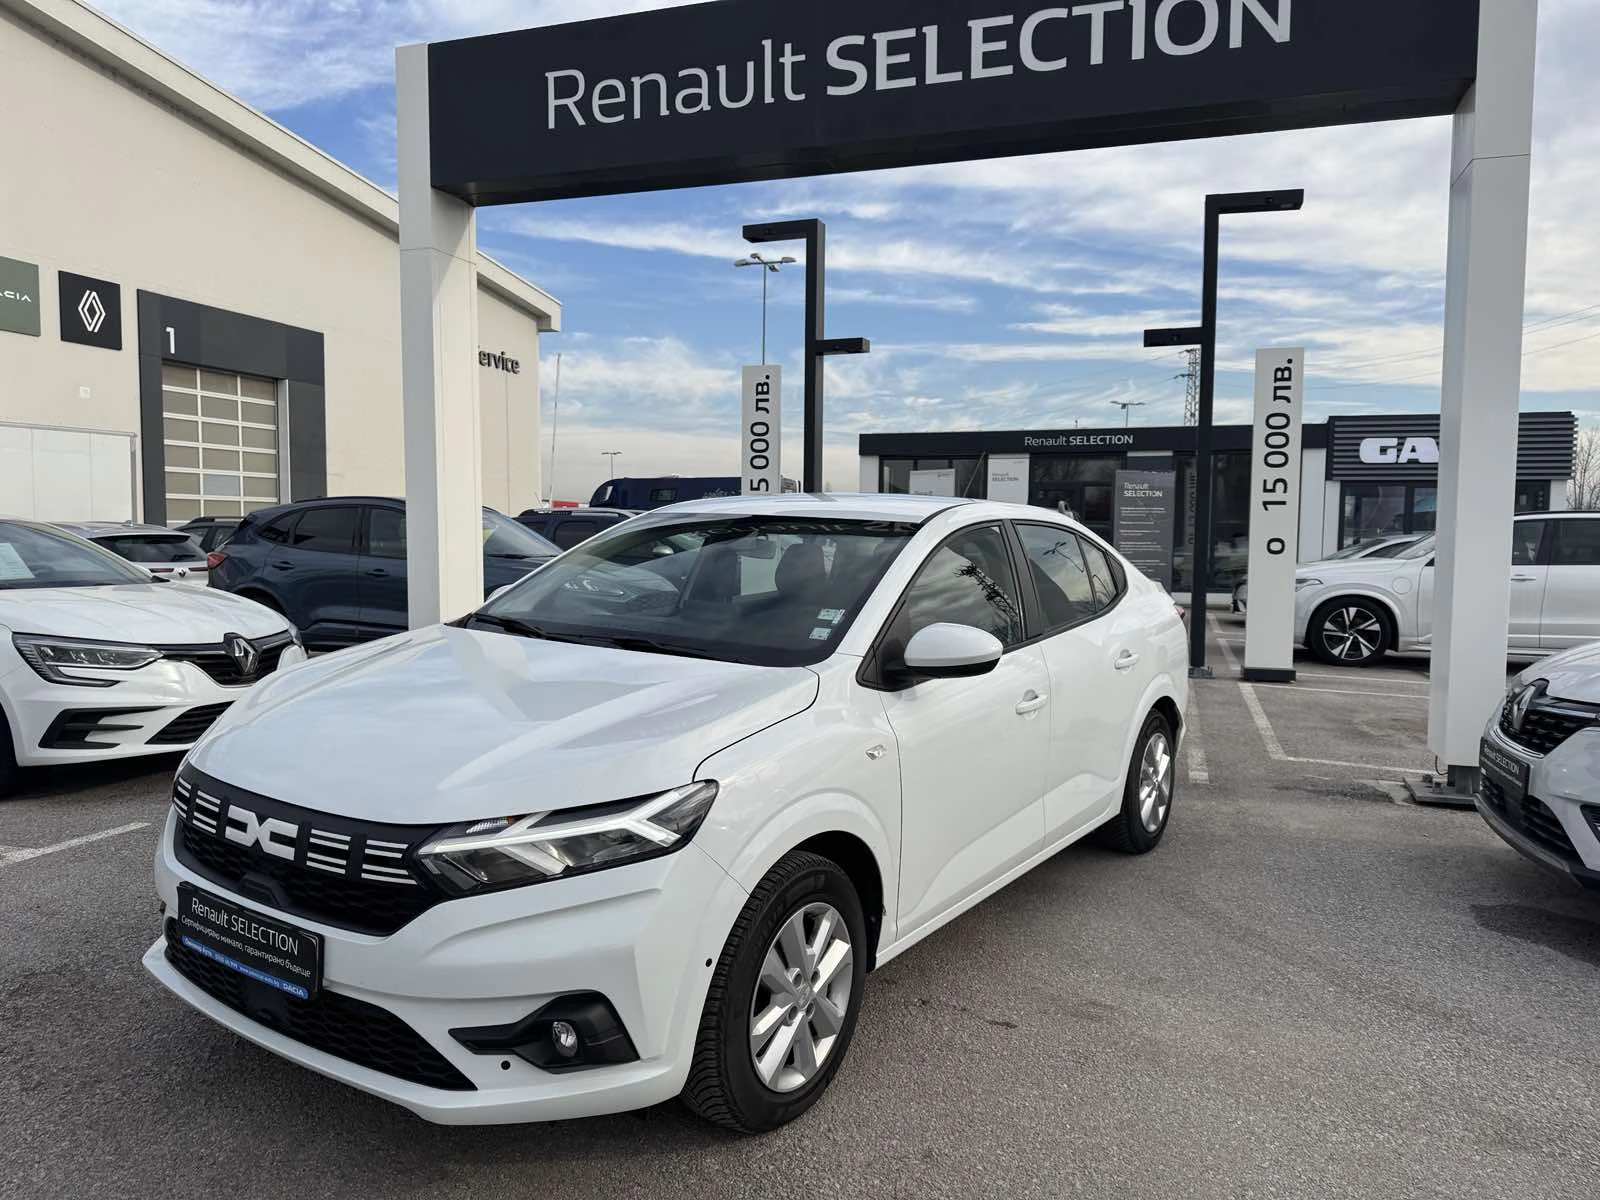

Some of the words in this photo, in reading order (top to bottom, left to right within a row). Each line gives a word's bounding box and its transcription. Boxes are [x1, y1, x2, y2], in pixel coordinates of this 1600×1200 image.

[545, 39, 806, 129] Renault
[825, 0, 1291, 96] SELECTION
[0, 290, 32, 302] CIA
[165, 326, 175, 354] 1
[478, 344, 520, 374] ervice
[755, 374, 770, 414] лв.
[1273, 358, 1293, 404] лв.
[749, 421, 769, 470] 000
[1024, 436, 1068, 447] Renault
[1068, 435, 1134, 446] SELECTION
[1263, 412, 1291, 468] 000
[1359, 437, 1440, 464] GA
[1262, 477, 1288, 511] 15
[181, 914, 220, 941] Сертифицирано
[244, 944, 285, 966] гарантирано
[285, 958, 311, 978] бъдеще
[191, 897, 229, 928] Renault
[231, 915, 298, 956] SELECTION
